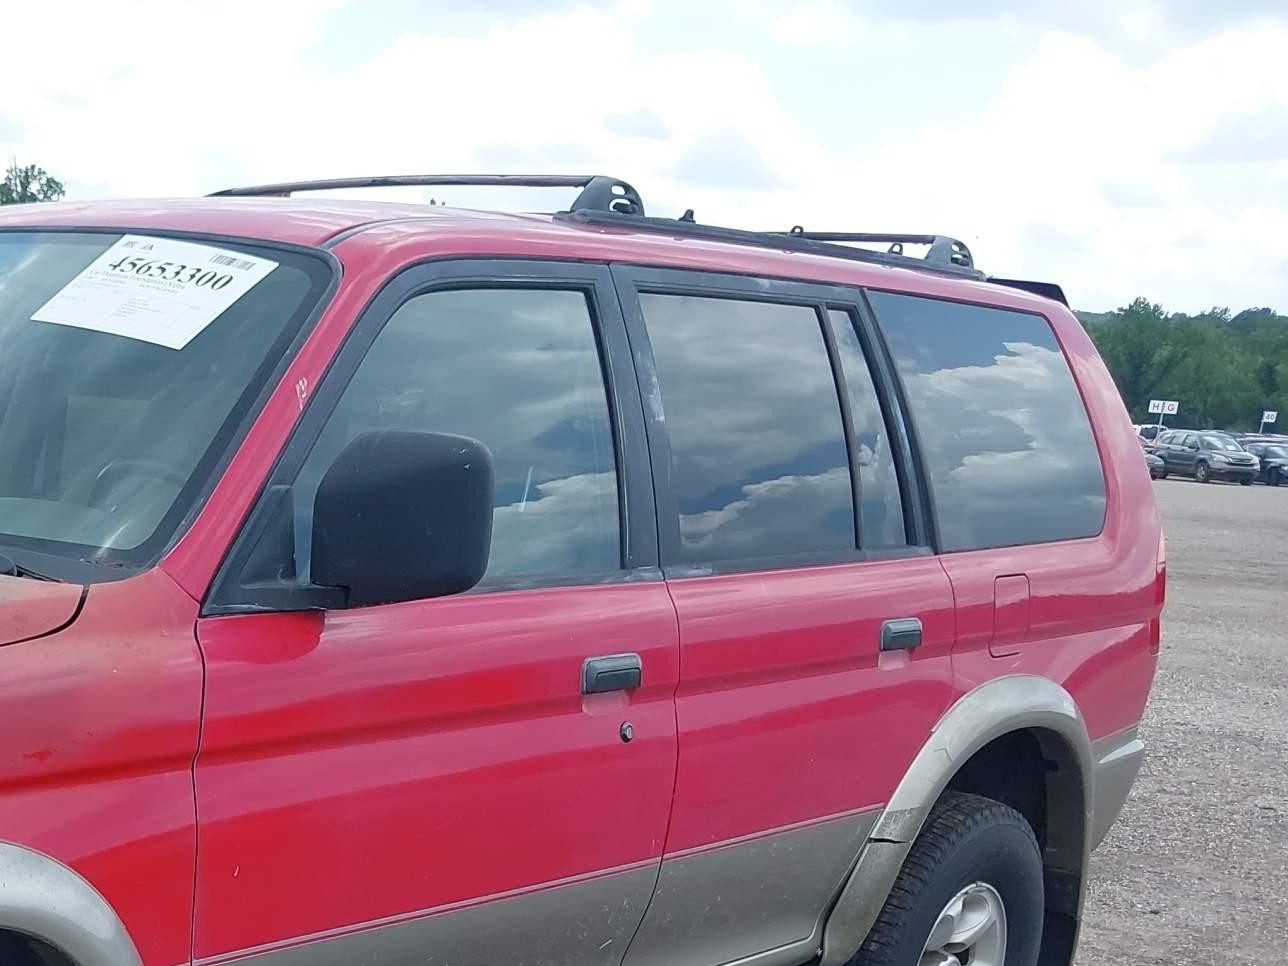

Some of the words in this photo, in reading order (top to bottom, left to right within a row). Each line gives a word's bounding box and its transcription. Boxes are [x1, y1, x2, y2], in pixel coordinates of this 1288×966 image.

[108, 256, 234, 291] 45653300
[1152, 403, 1160, 411] H
[1167, 403, 1175, 412] G
